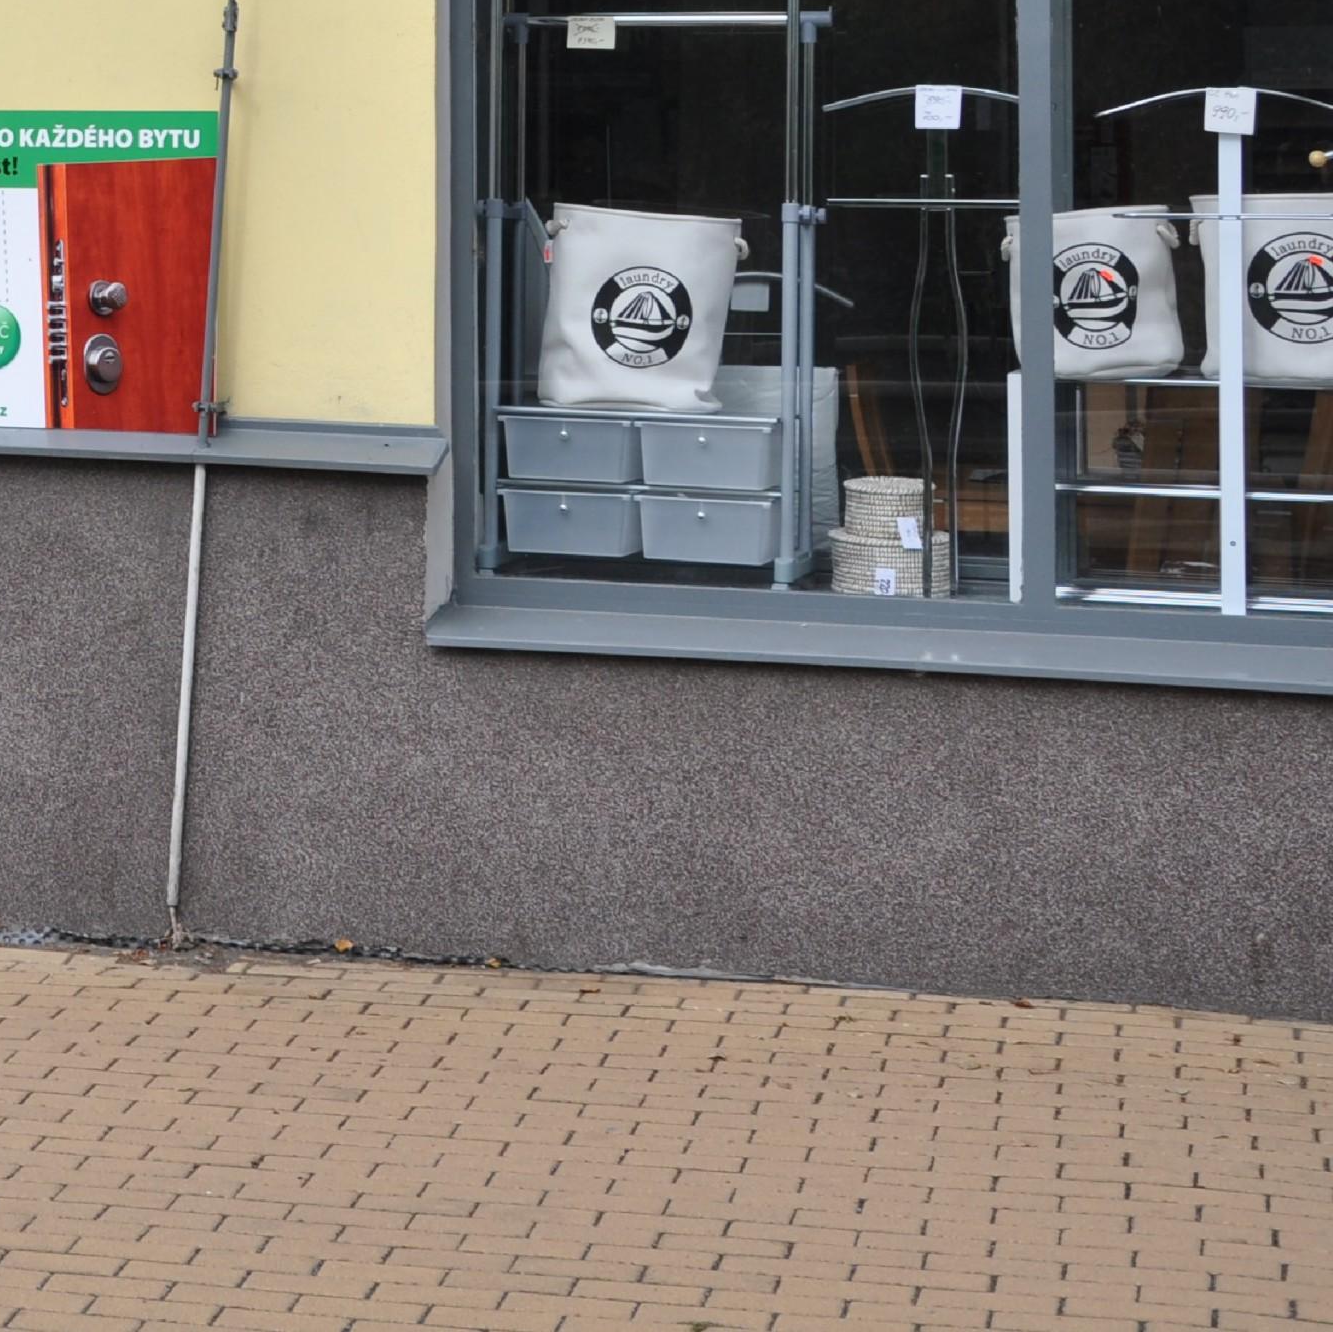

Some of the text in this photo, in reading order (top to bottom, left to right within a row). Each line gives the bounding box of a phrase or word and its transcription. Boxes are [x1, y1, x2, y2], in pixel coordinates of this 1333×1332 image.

[19, 125, 133, 149] KAŽDÉHO
[138, 129, 201, 149] BYTU
[1271, 238, 1333, 256] laundry
[1059, 248, 1117, 268] laundry
[620, 273, 673, 289] laundry
[1083, 332, 1120, 346] NO.1
[1291, 326, 1331, 339] NO.1
[621, 353, 653, 365] NO.1
